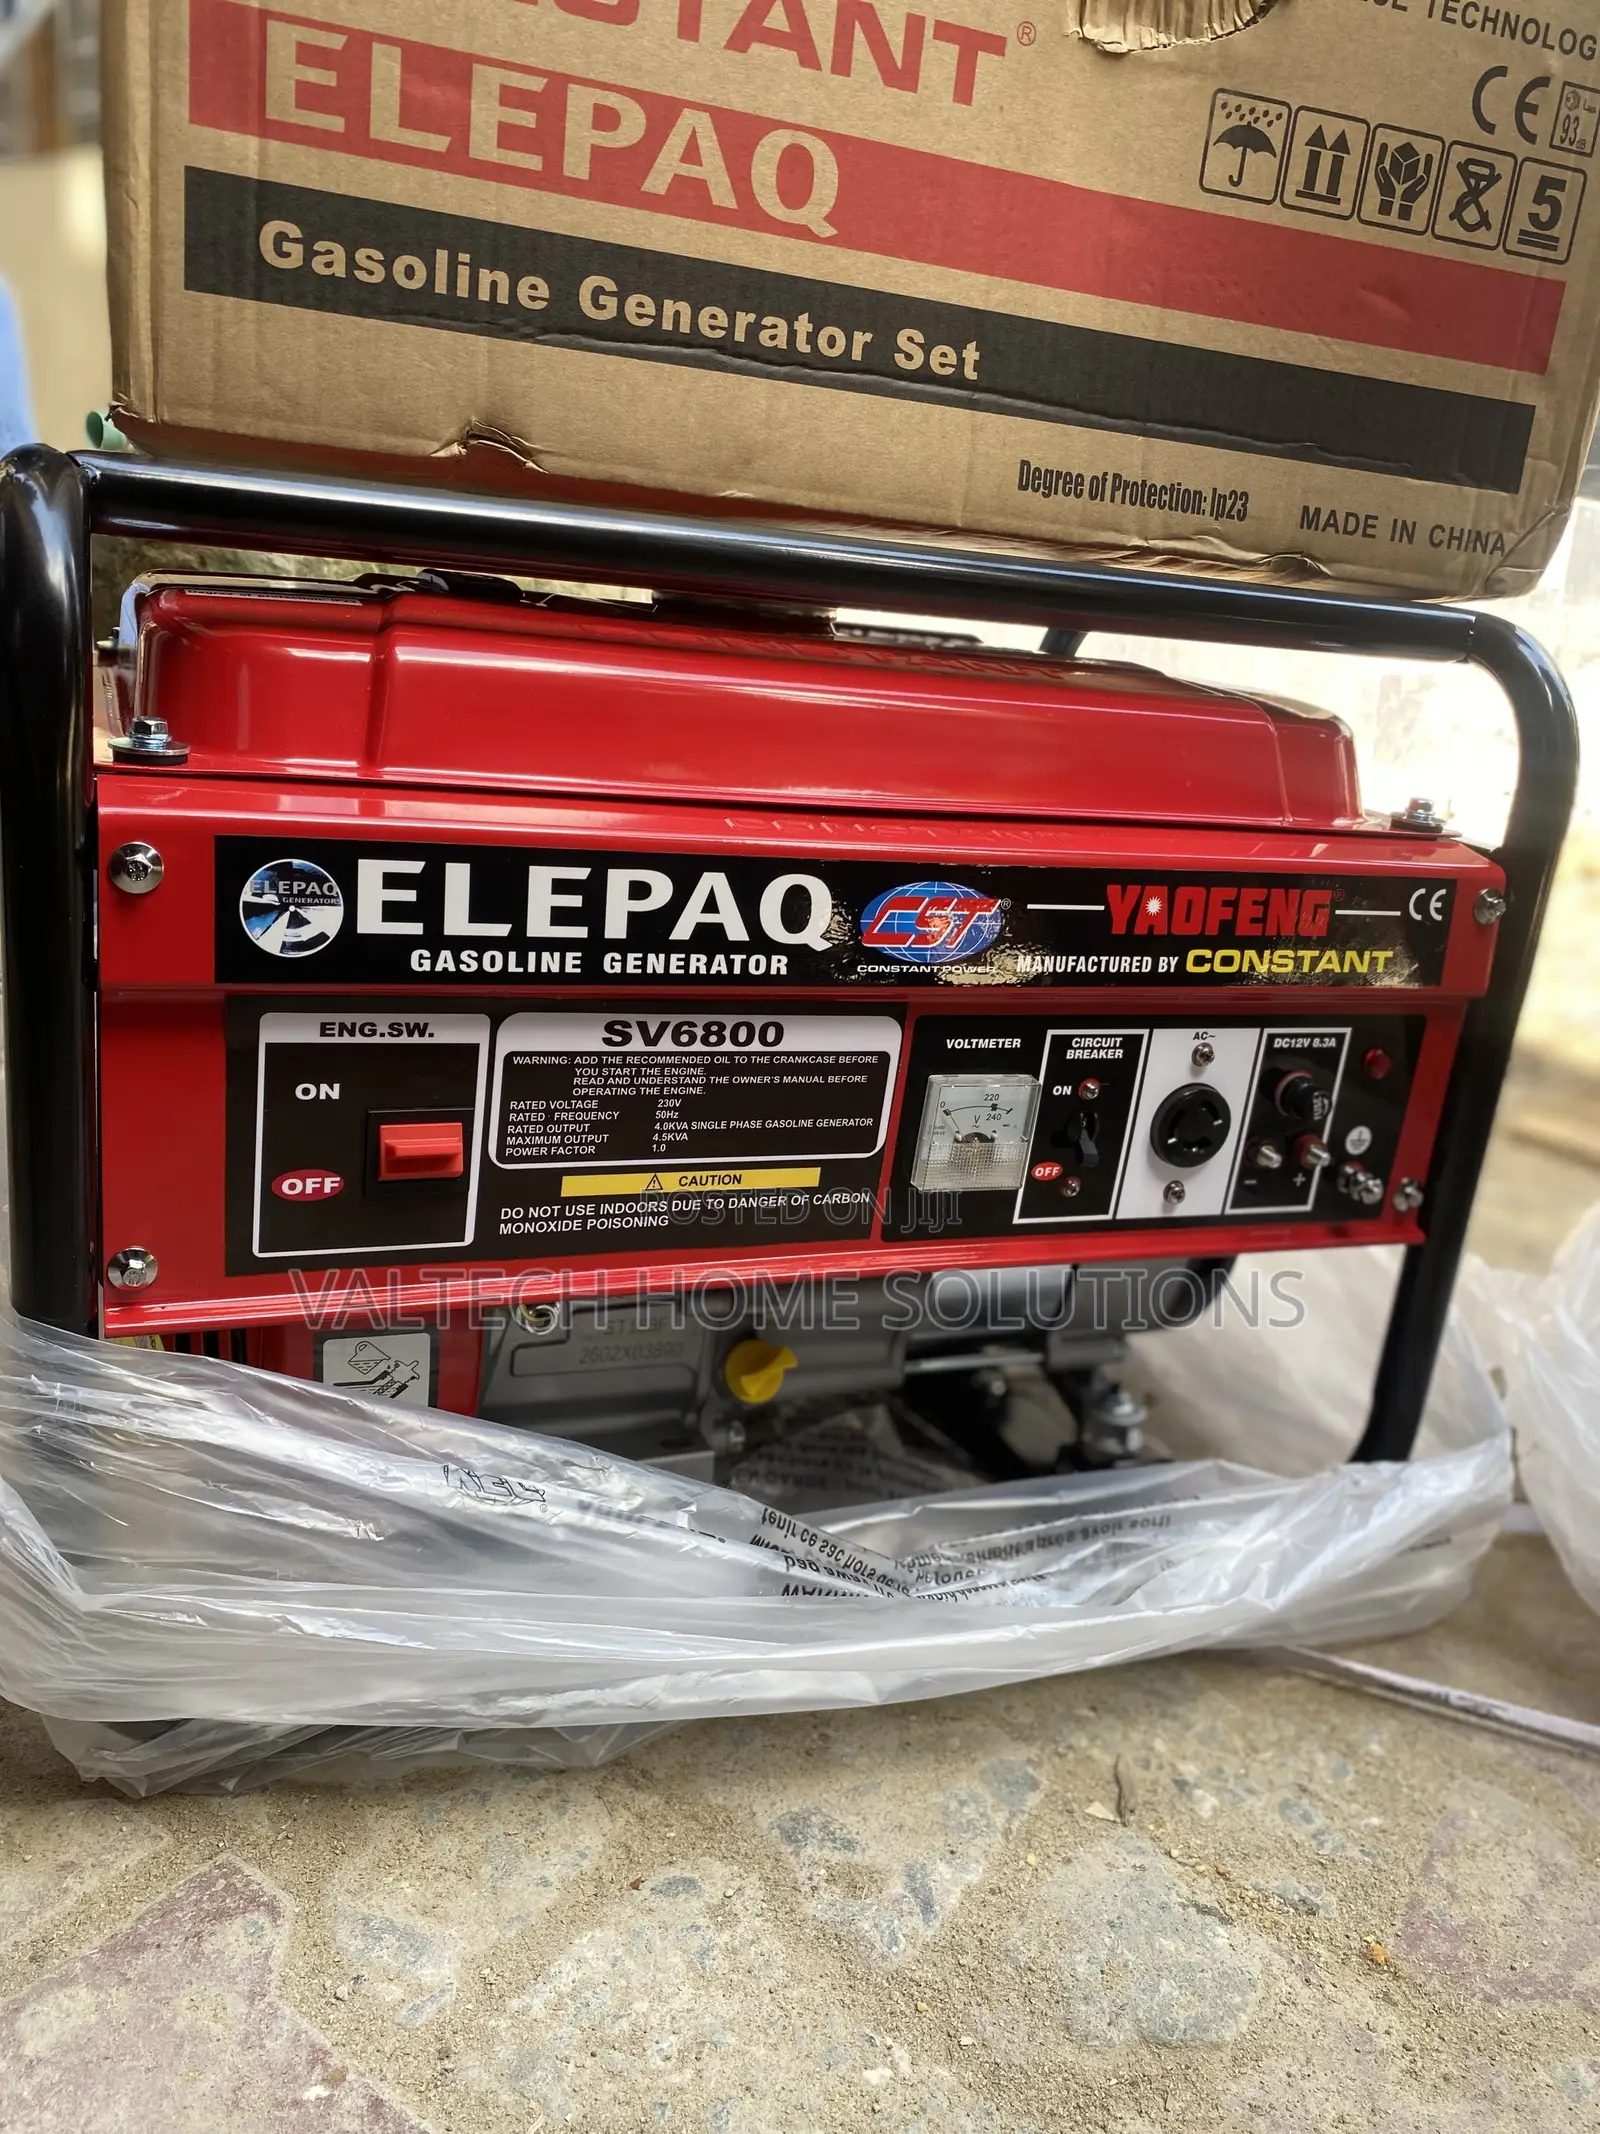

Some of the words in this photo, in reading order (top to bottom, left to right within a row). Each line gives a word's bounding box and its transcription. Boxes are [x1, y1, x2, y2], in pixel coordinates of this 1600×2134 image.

[265, 18, 840, 238] ELEPAQ
[1560, 114, 1580, 146] 93
[1527, 175, 1568, 231] 5
[258, 219, 550, 311] Gasoline
[578, 275, 874, 362] Generator
[893, 327, 981, 381] Set
[1017, 459, 1085, 499] Degree
[1088, 472, 1109, 502] of
[1109, 472, 1208, 517] Protection:
[1208, 487, 1250, 522] Ip23
[1300, 504, 1379, 541] MADE
[1390, 519, 1419, 546] IN
[1427, 523, 1507, 559] CHINA
[250, 879, 339, 897] ELEPAQ
[282, 896, 342, 906] GENERATORS
[356, 858, 834, 953] ELEPAQ
[1106, 884, 1334, 937] YAOFENG
[410, 949, 583, 975] GASOLINE
[603, 952, 789, 977] GENERATOR
[1016, 954, 1153, 974] MANUFACTURED
[1158, 955, 1180, 974] BY
[1184, 948, 1395, 974] CONSTANT
[319, 1021, 435, 1038] ENG.SW.
[601, 1019, 785, 1048] SV6800
[946, 1038, 1022, 1049] VOLTMETER
[1071, 1037, 1123, 1048] CIRCUIT
[1273, 1038, 1310, 1048] DC12V
[1312, 1038, 1337, 1048] 8.3A
[1066, 1049, 1124, 1060] BREAKER
[512, 1056, 572, 1066] WARNING:
[574, 1056, 599, 1065] ADD
[602, 1056, 624, 1065] THE
[626, 1056, 711, 1065] RECOMMENDED
[713, 1055, 731, 1064] OIL
[734, 1055, 748, 1064] TO
[751, 1055, 770, 1064] THE
[772, 1055, 836, 1064] CRANKCASE
[838, 1055, 879, 1064] BEFORE
[575, 1067, 599, 1076] YOU
[602, 1067, 637, 1076] START
[640, 1067, 662, 1076] THE
[664, 1067, 707, 1076] ENGINE.
[573, 1077, 605, 1086] READ
[606, 1076, 631, 1085] AND
[633, 1076, 707, 1085] UNDERSTAND
[709, 1076, 730, 1085] THE
[732, 1075, 781, 1085] OWNER'S
[782, 1075, 825, 1084] MANUAL
[828, 1075, 868, 1084] BEFORE
[295, 1082, 341, 1101] ON
[572, 1087, 637, 1096] OPERATING
[640, 1087, 661, 1096] THE
[663, 1086, 707, 1095] ENGINE.
[1052, 1085, 1073, 1096] ON
[984, 1093, 1000, 1102] 220
[509, 1101, 547, 1110] RATED
[549, 1100, 599, 1110] VOLTAGE
[657, 1099, 682, 1108] 230V
[939, 1101, 946, 1109] 0
[509, 1112, 546, 1122] RATED
[554, 1111, 620, 1121] FREQUENCY
[655, 1110, 680, 1120] 50Hz
[986, 1113, 1002, 1121] 240
[507, 1124, 544, 1134] RATED
[546, 1123, 591, 1133] OUTPUT
[654, 1121, 689, 1131] 4.0KVA
[690, 1120, 728, 1130] SINGLE
[729, 1120, 763, 1130] PHASE
[764, 1119, 814, 1129] GASOLINE
[815, 1117, 874, 1128] GENERATOR
[506, 1135, 561, 1146] MAXIMUM
[563, 1134, 610, 1144] OUTPUT
[652, 1132, 689, 1142] 4.5KVA
[505, 1147, 548, 1157] POWER
[550, 1145, 596, 1156] FACTOR
[651, 1143, 667, 1152] 1.0
[1034, 1166, 1060, 1177] OFF
[281, 1176, 342, 1195] OFF
[678, 1173, 742, 1187] CAUTION
[500, 1207, 524, 1220] DO
[528, 1205, 561, 1219] NOT
[565, 1203, 596, 1217] USE
[599, 1200, 668, 1215] INDOORS
[671, 1199, 702, 1212] DUE
[706, 1198, 725, 1210] TO
[728, 1196, 787, 1209] DANGER
[790, 1194, 810, 1206] OF
[812, 1192, 871, 1205] CARBON
[499, 1219, 583, 1235] MONOXIDE
[586, 1215, 670, 1230] POISONING
